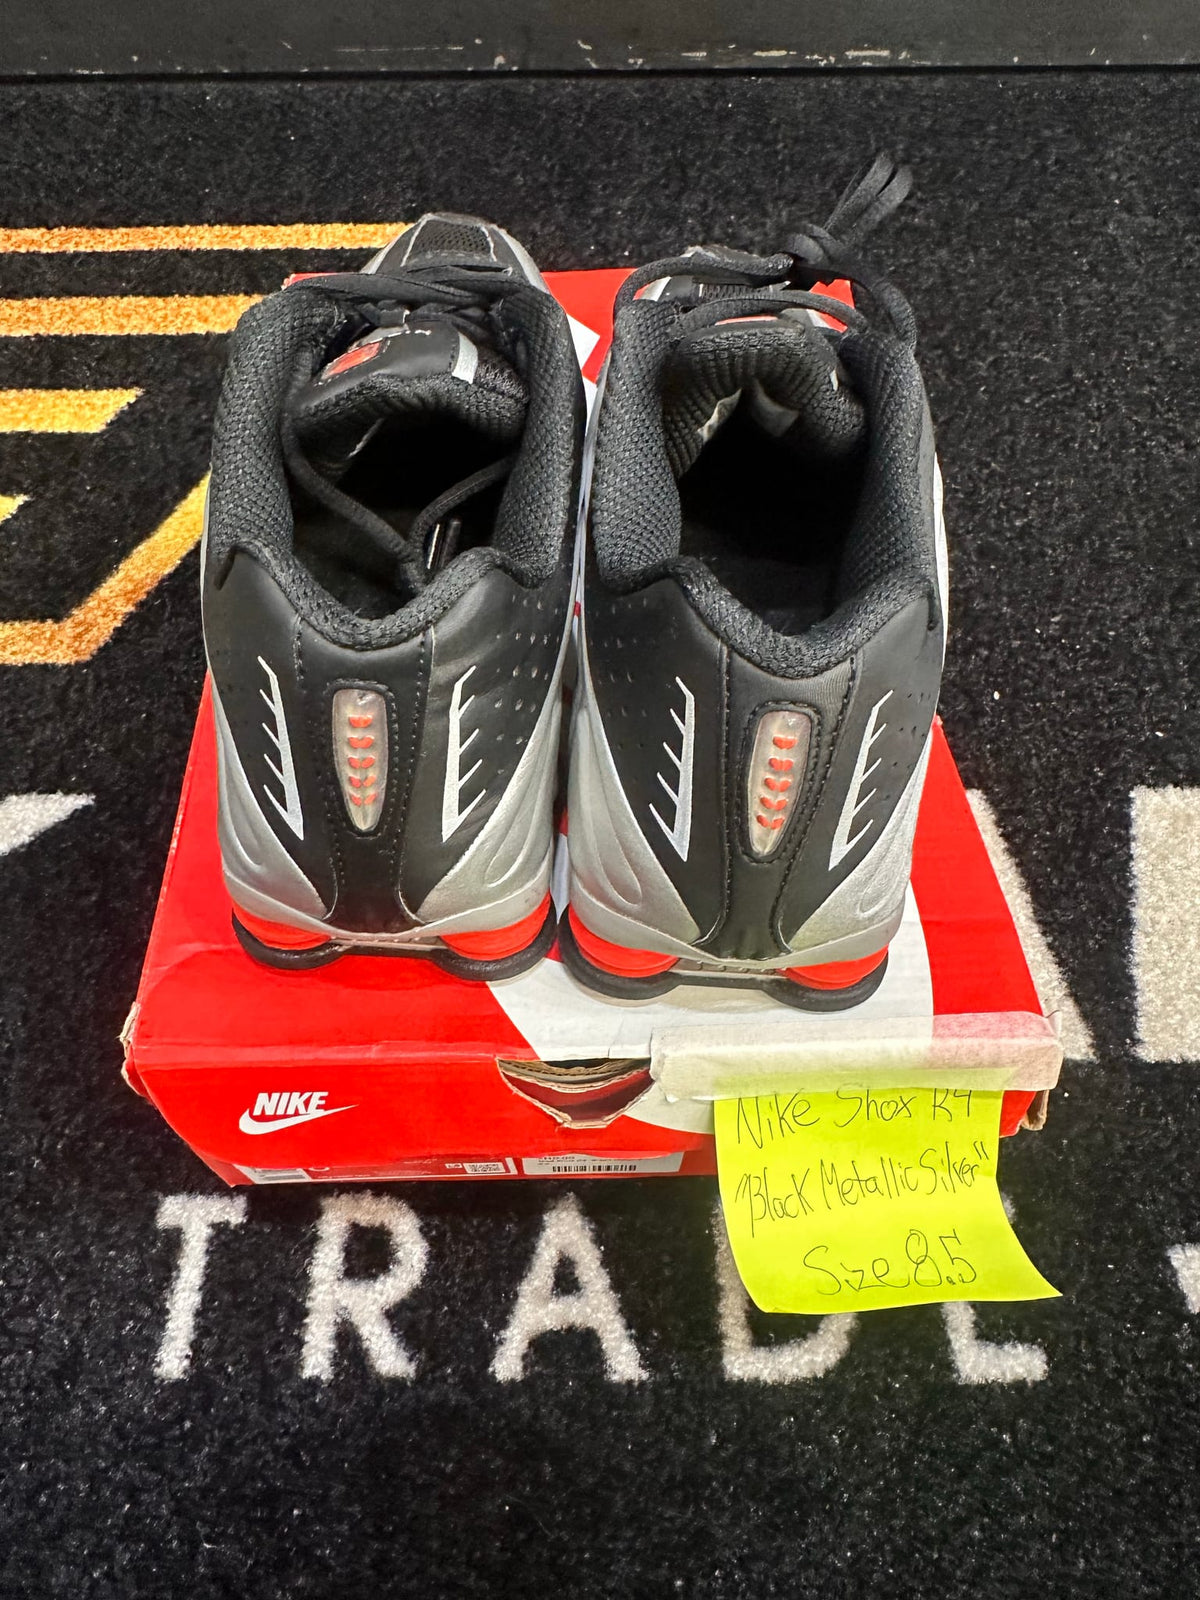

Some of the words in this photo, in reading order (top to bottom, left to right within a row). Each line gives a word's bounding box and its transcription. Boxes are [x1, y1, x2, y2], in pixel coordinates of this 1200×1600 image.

[252, 1091, 329, 1116] NIKE
[736, 1088, 820, 1149] Nike
[834, 1083, 916, 1127] Shox
[820, 1157, 918, 1210] Metallic
[803, 1245, 910, 1295] Size
[905, 1229, 976, 1287] 8.5
